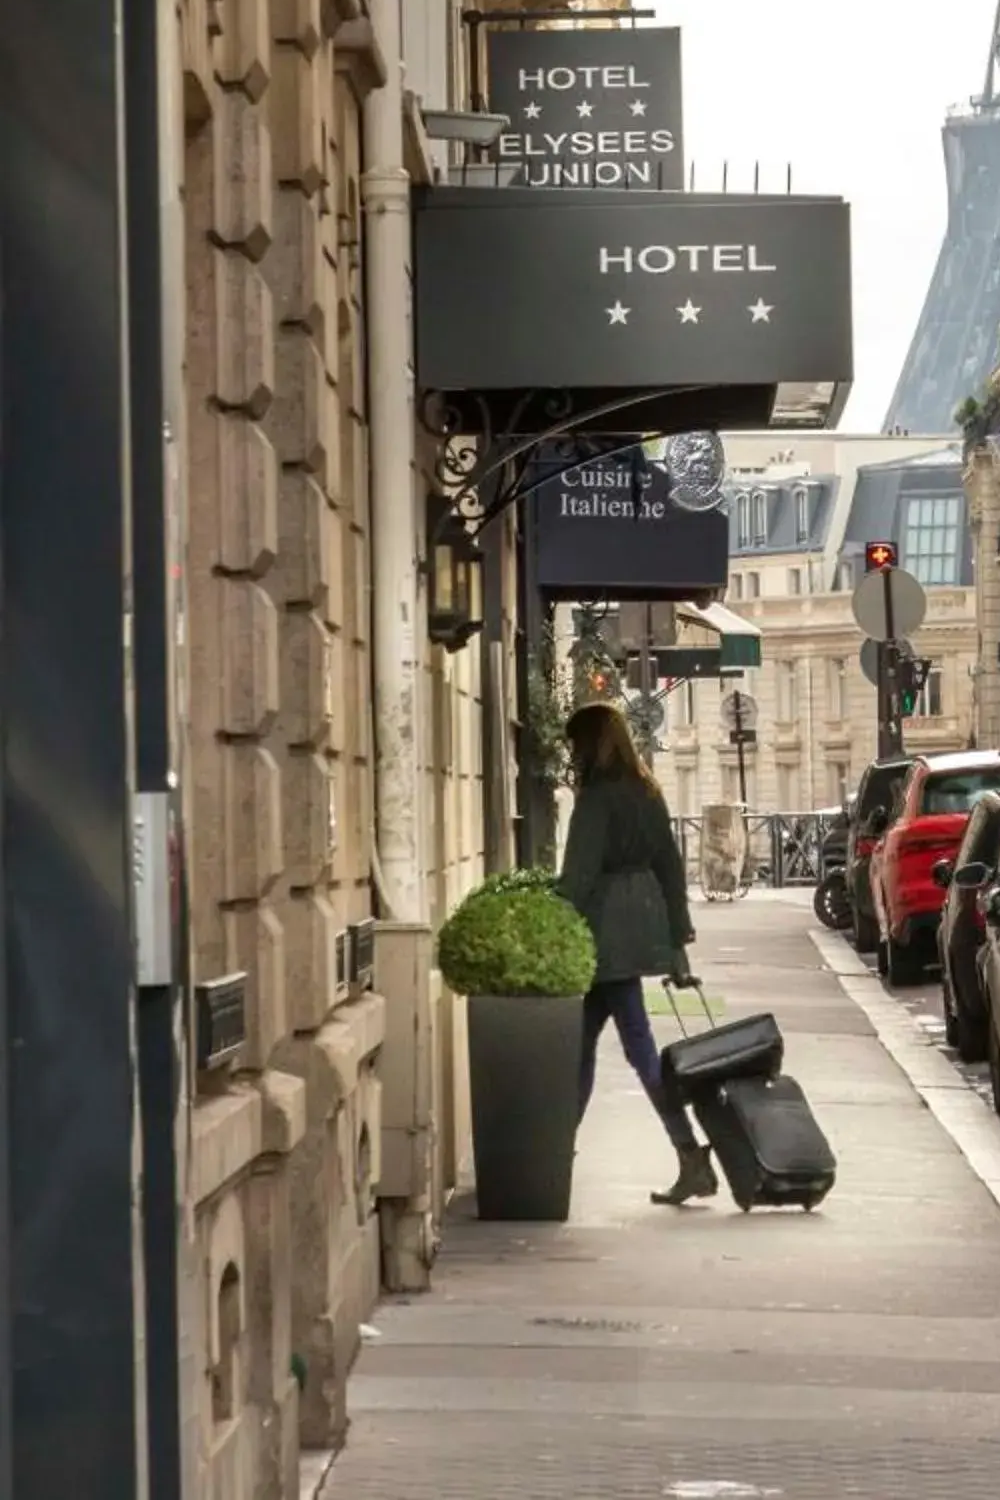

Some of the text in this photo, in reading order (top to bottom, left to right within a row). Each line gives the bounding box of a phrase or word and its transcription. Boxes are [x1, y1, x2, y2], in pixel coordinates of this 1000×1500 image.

[518, 65, 650, 90] HOTEL
[500, 129, 674, 156] ELYSEES
[524, 161, 650, 186] UNION
[600, 244, 776, 274] HOTEL
